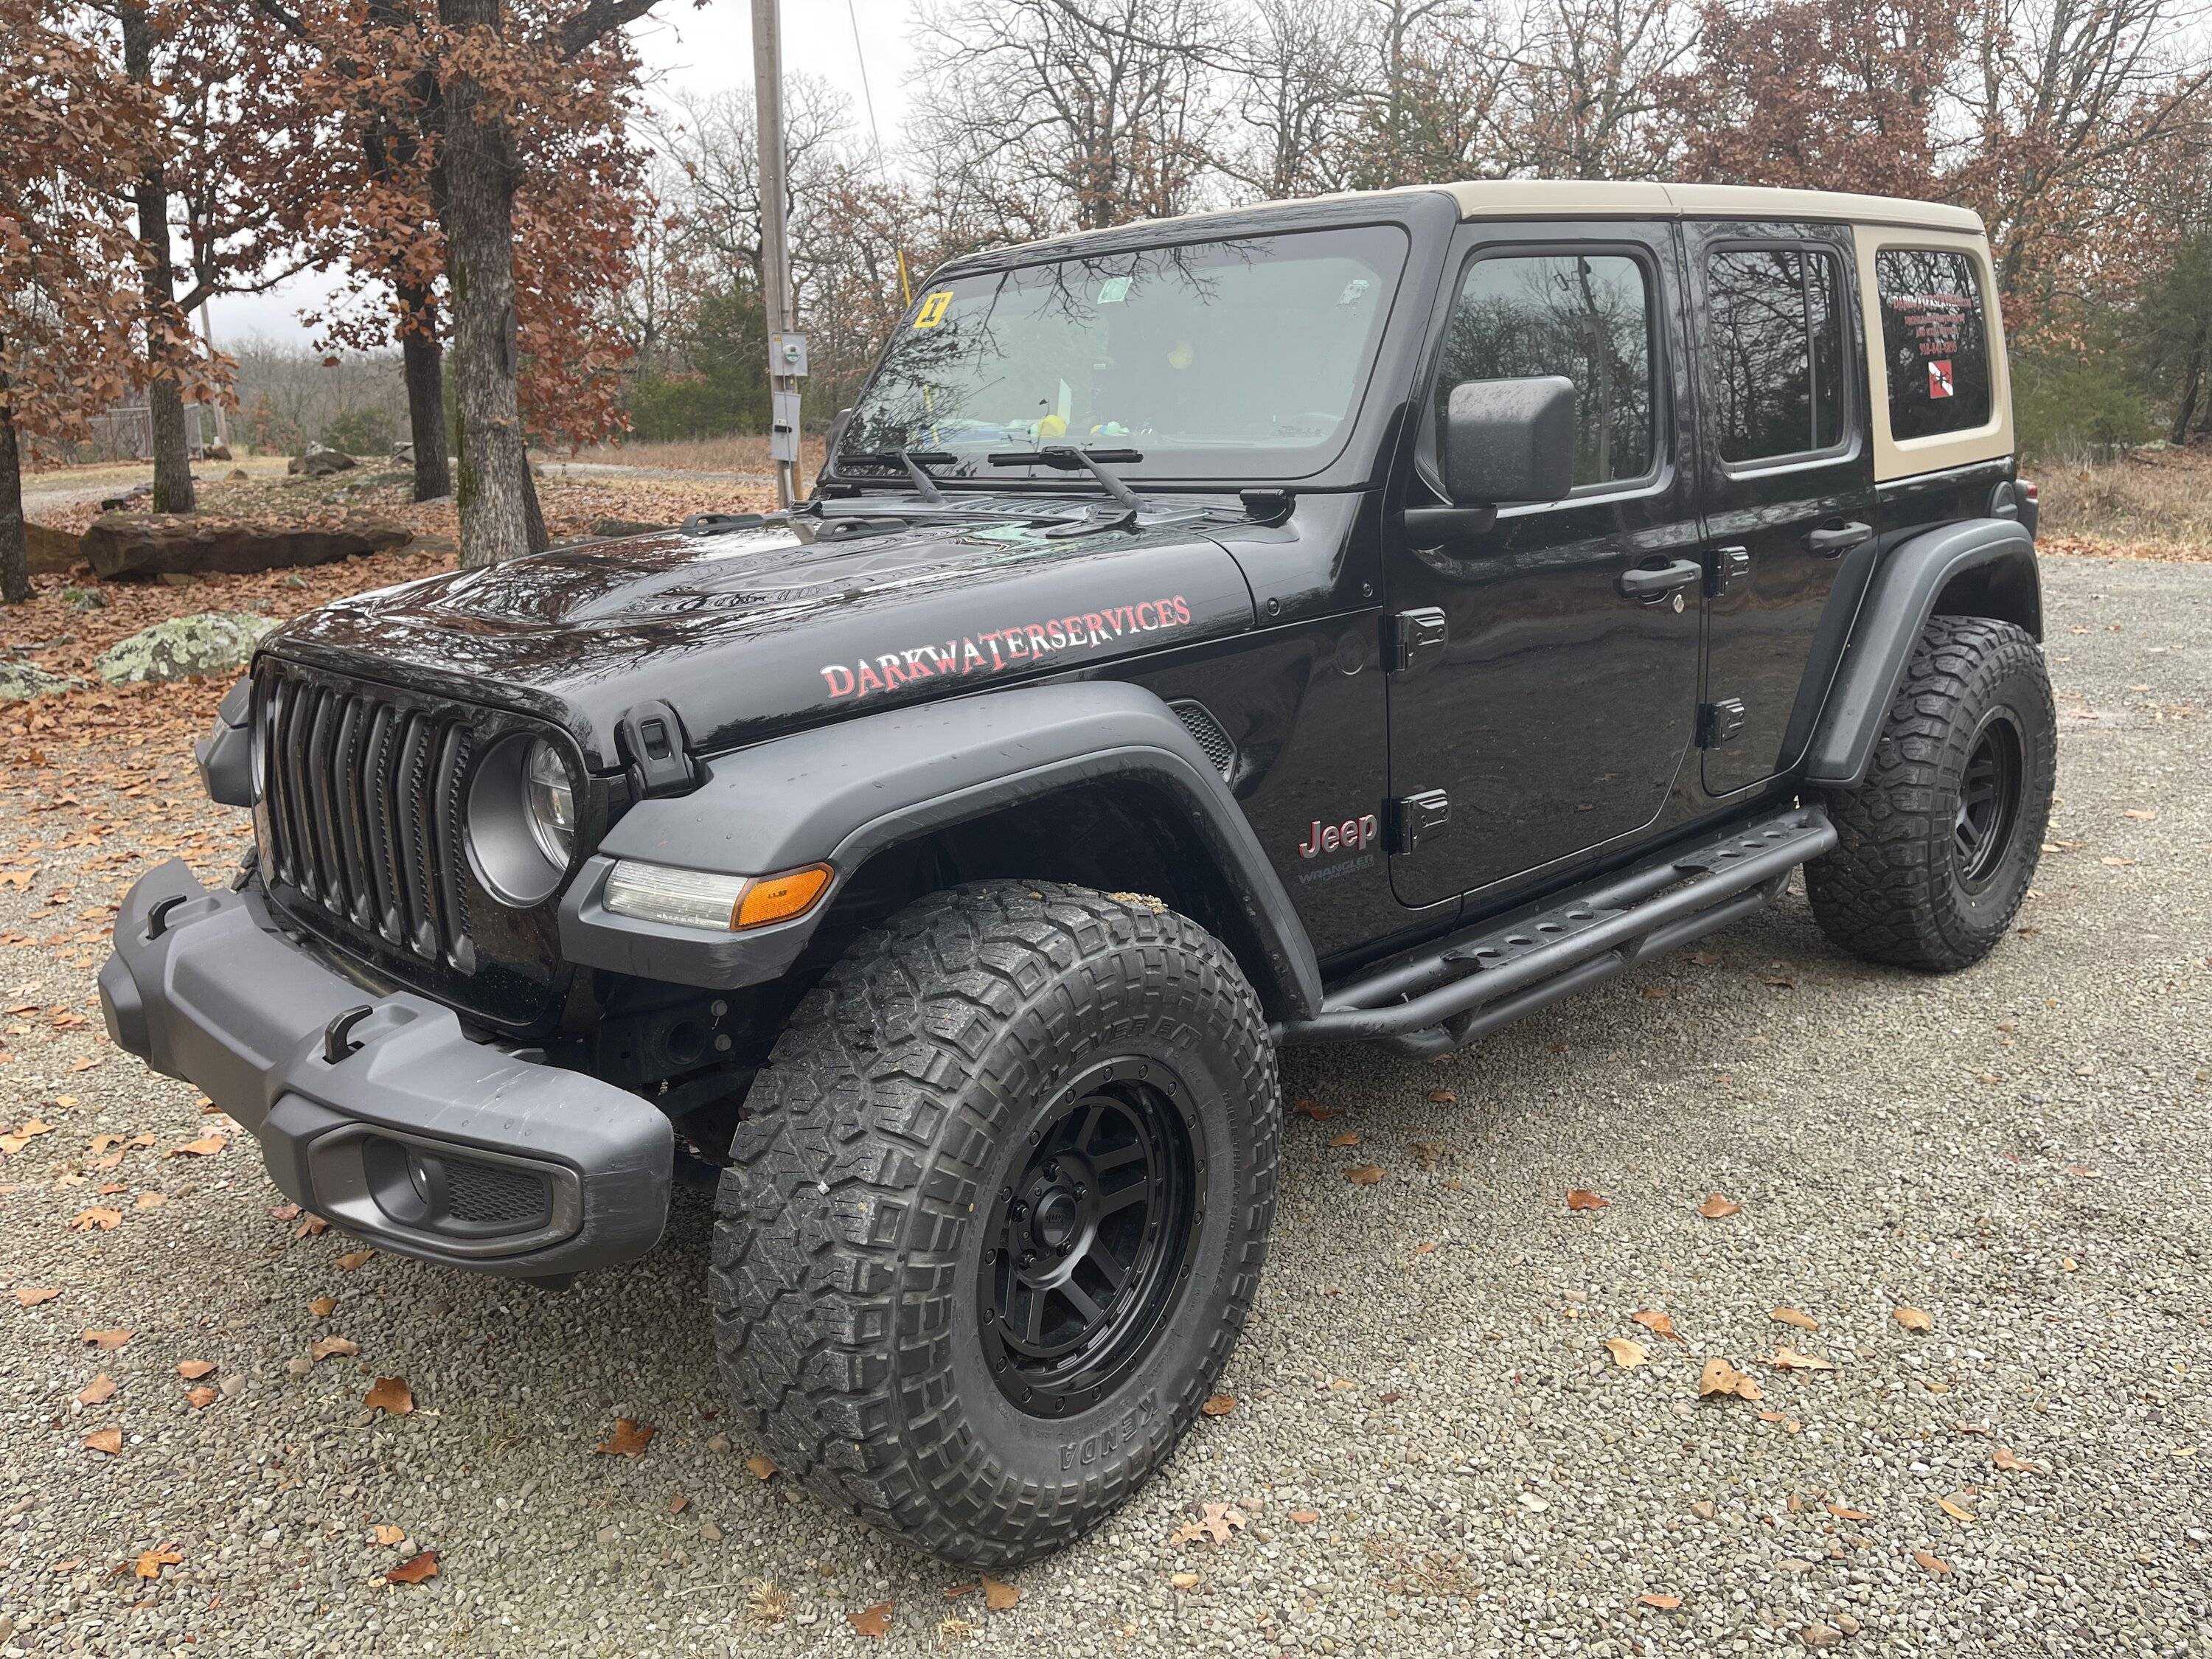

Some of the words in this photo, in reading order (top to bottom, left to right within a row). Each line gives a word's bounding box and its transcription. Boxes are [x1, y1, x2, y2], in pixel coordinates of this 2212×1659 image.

[820, 595, 1192, 698] DARKWATERSERVICES
[1298, 814, 1377, 861] Jeep
[1298, 855, 1374, 884] WRANGLER
[1059, 1388, 1162, 1472] KENDA
